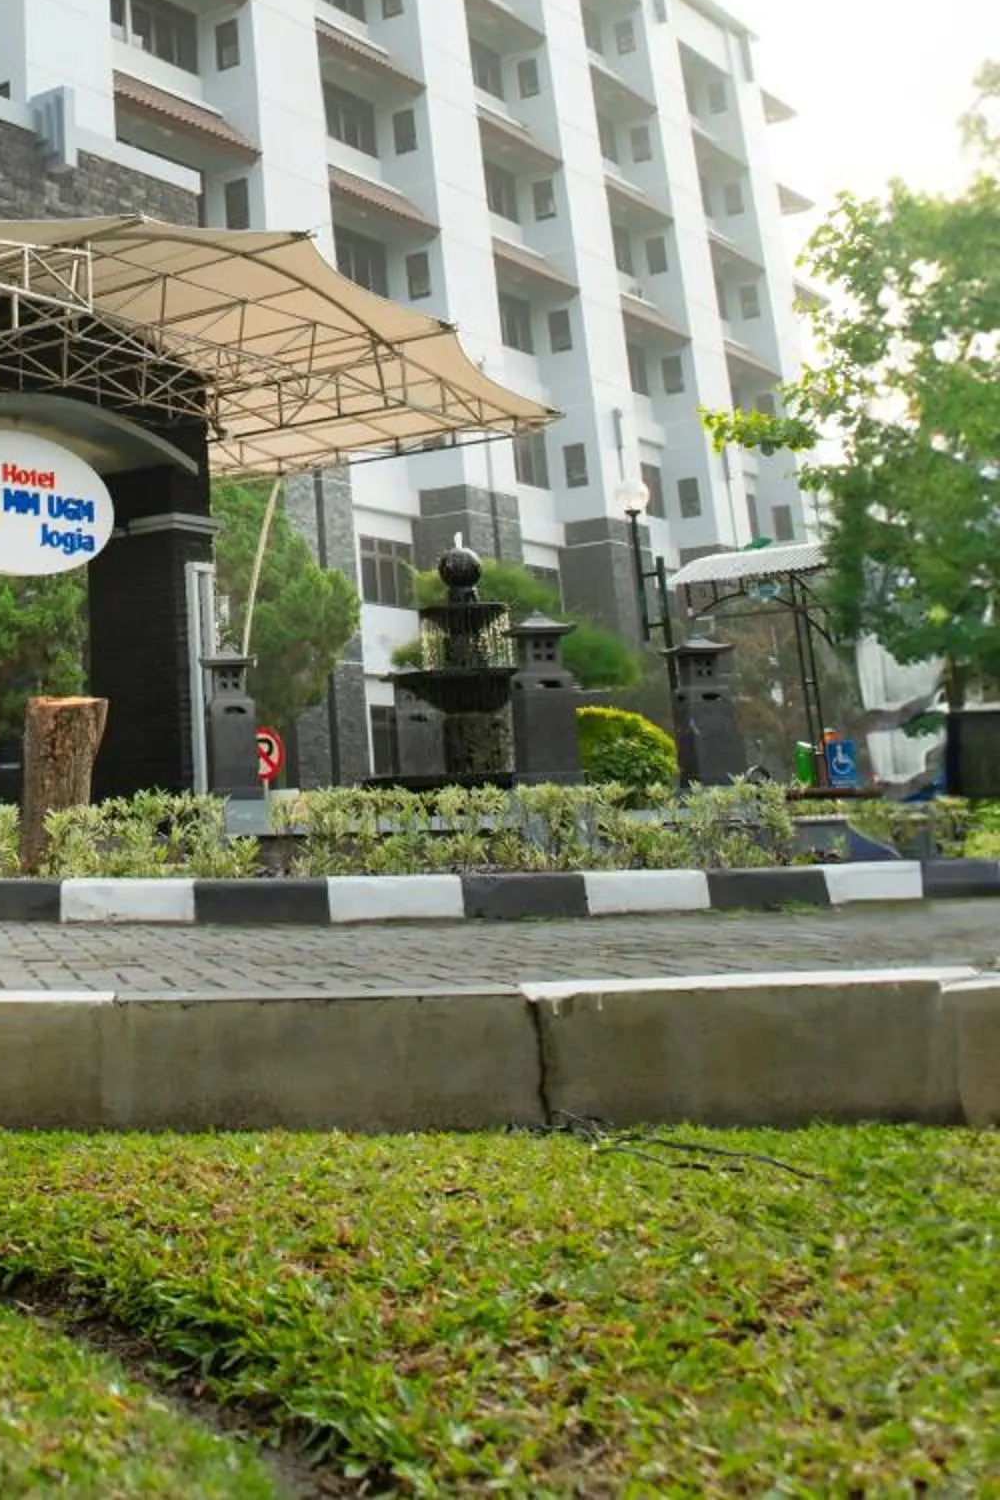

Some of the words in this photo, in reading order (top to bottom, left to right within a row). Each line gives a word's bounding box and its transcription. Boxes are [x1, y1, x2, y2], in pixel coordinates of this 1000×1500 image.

[2, 462, 55, 489] Hotel
[3, 488, 40, 516] MM
[47, 494, 94, 523] UGM
